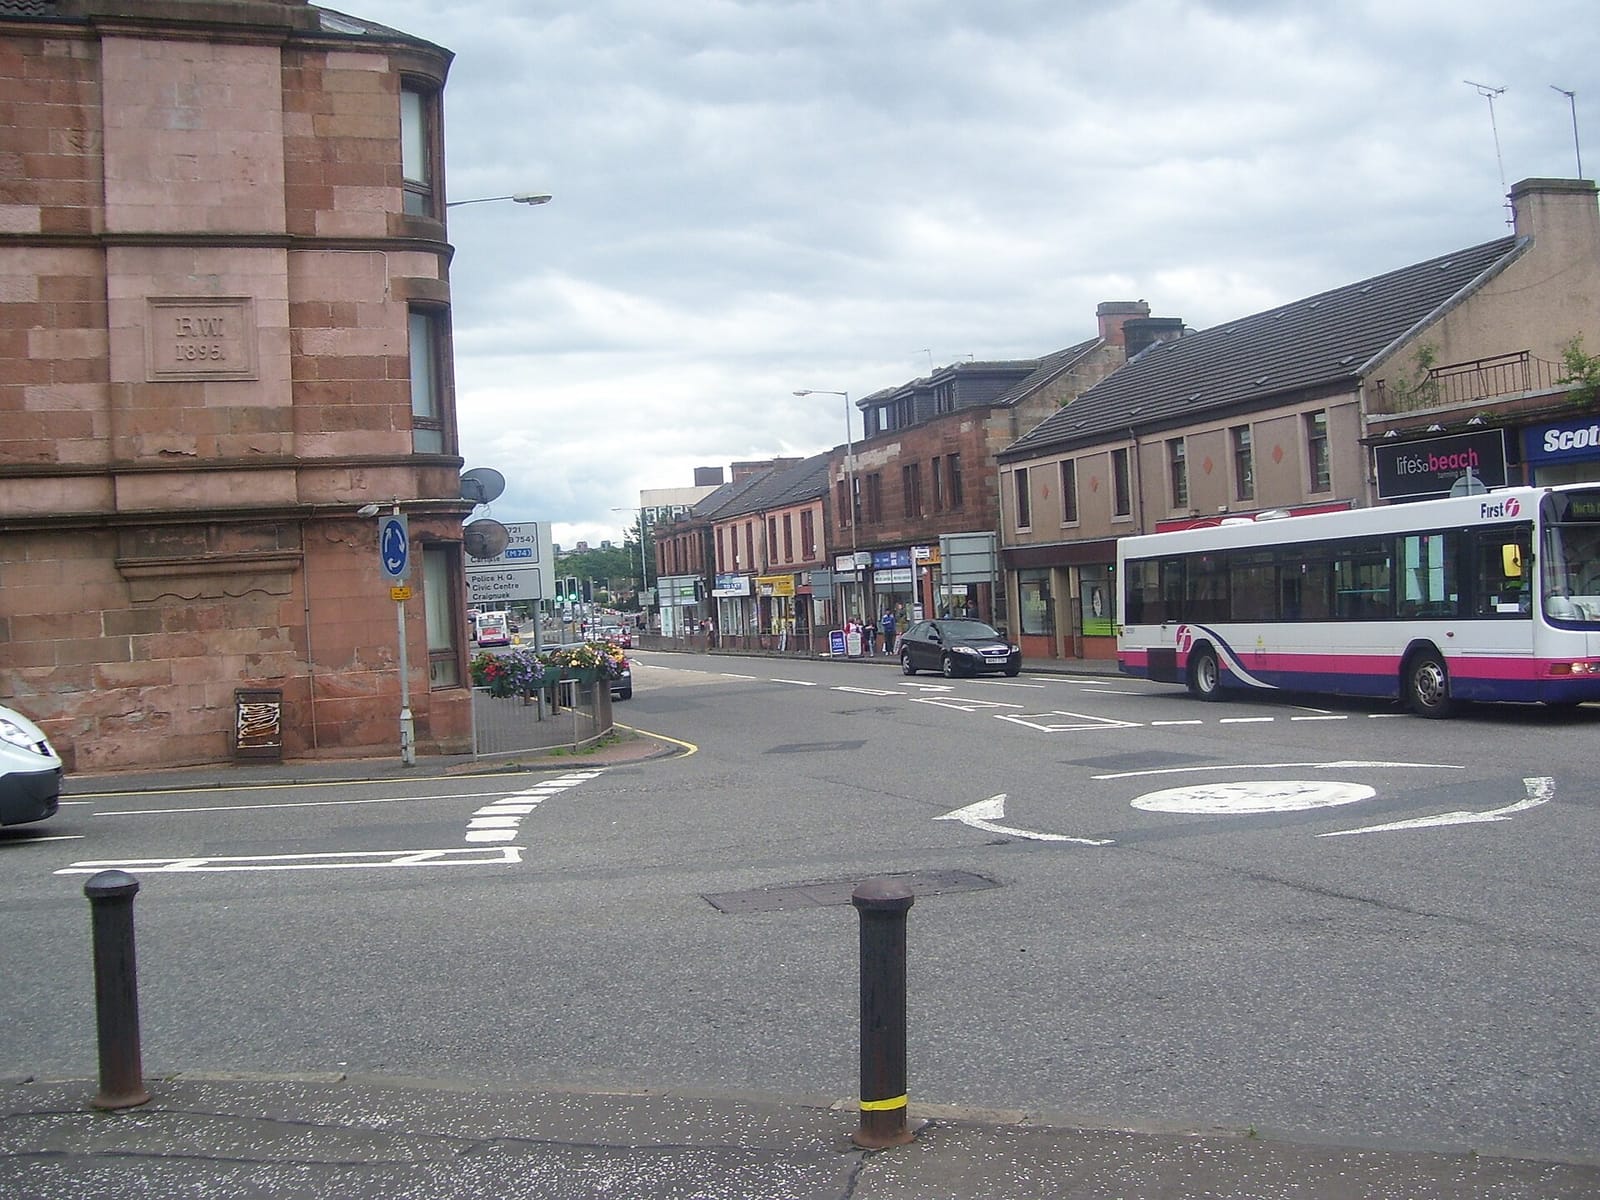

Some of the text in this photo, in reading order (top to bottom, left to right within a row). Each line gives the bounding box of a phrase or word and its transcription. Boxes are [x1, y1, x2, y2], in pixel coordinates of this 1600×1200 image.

[1543, 425, 1600, 452] Scot
[1428, 448, 1480, 472] beach
[1481, 502, 1504, 519] First
